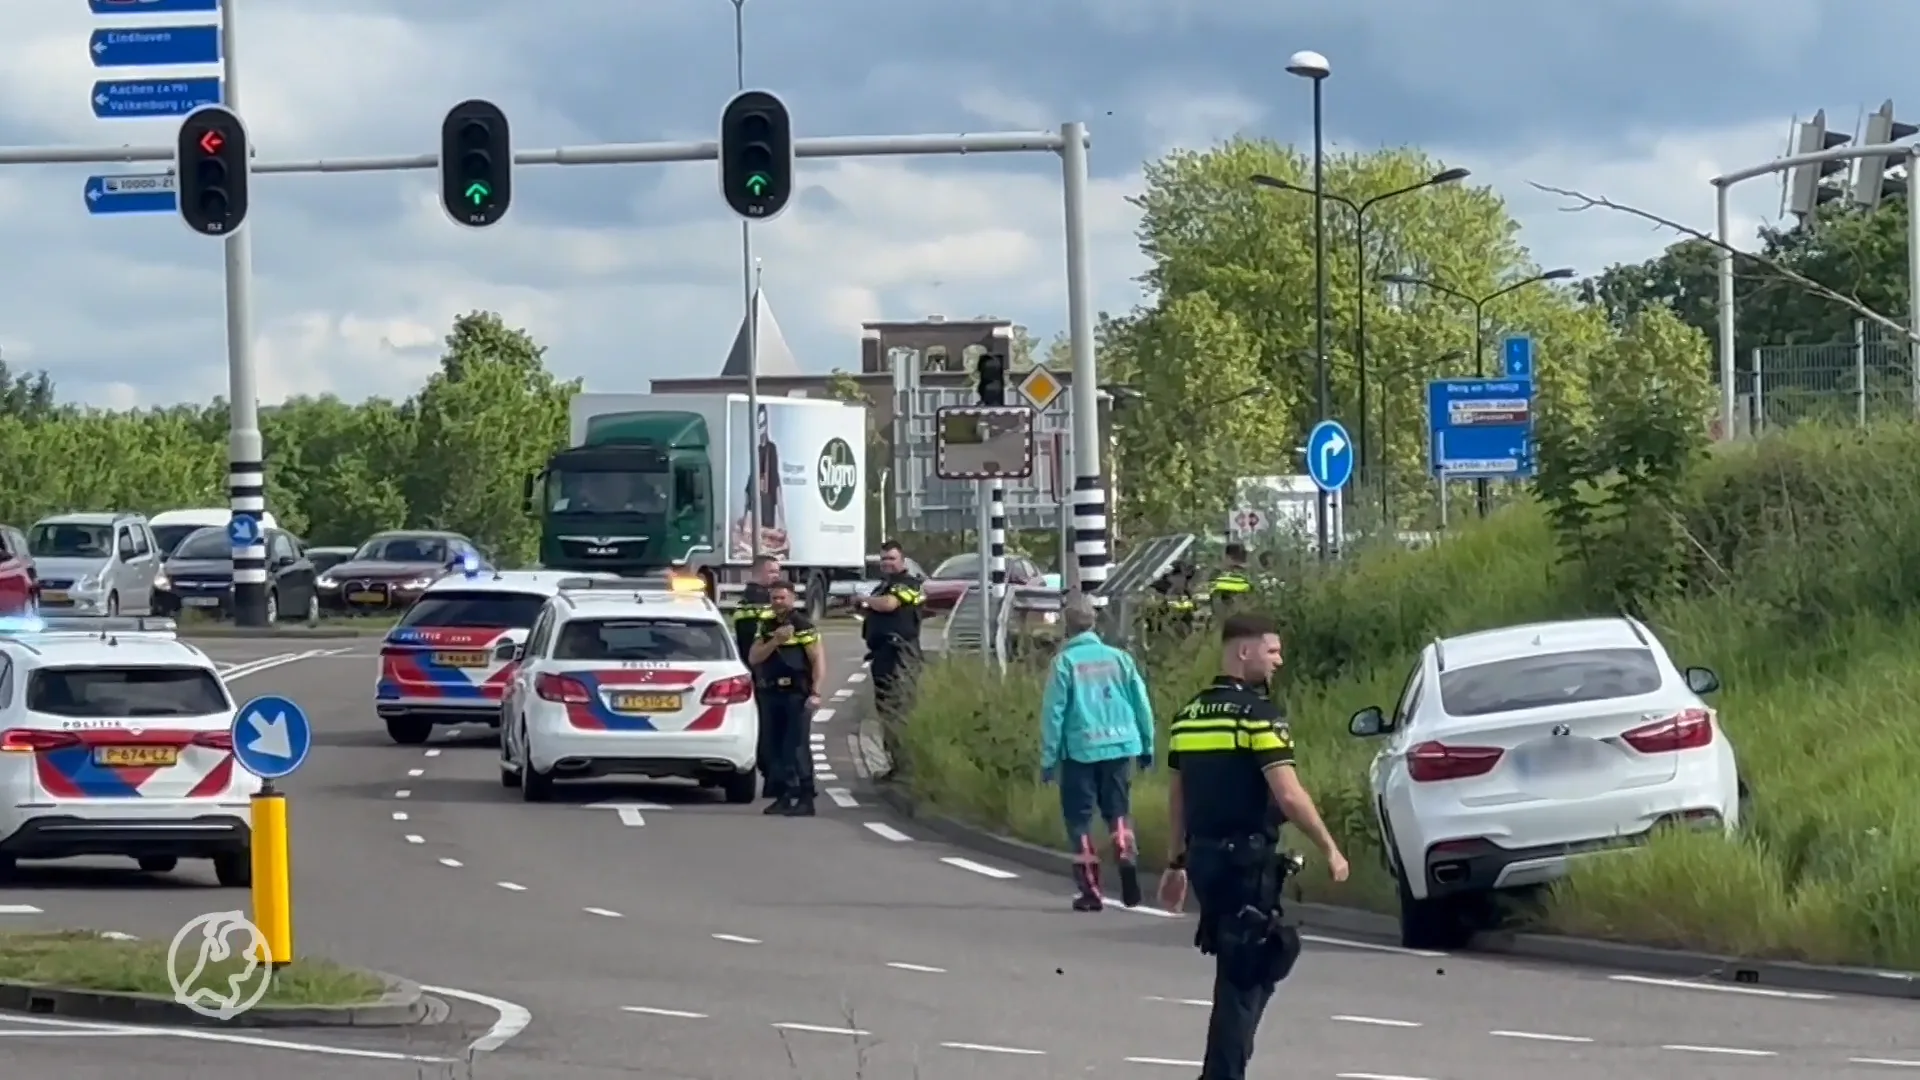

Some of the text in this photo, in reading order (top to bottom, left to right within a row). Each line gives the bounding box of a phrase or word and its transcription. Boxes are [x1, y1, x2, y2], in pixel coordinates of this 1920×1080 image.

[108, 33, 172, 43] Eindhoven
[109, 84, 154, 95] Aachen
[109, 101, 178, 111] Valkenburg
[400, 631, 441, 641] POLITIE
[62, 720, 123, 730] POLITIE
